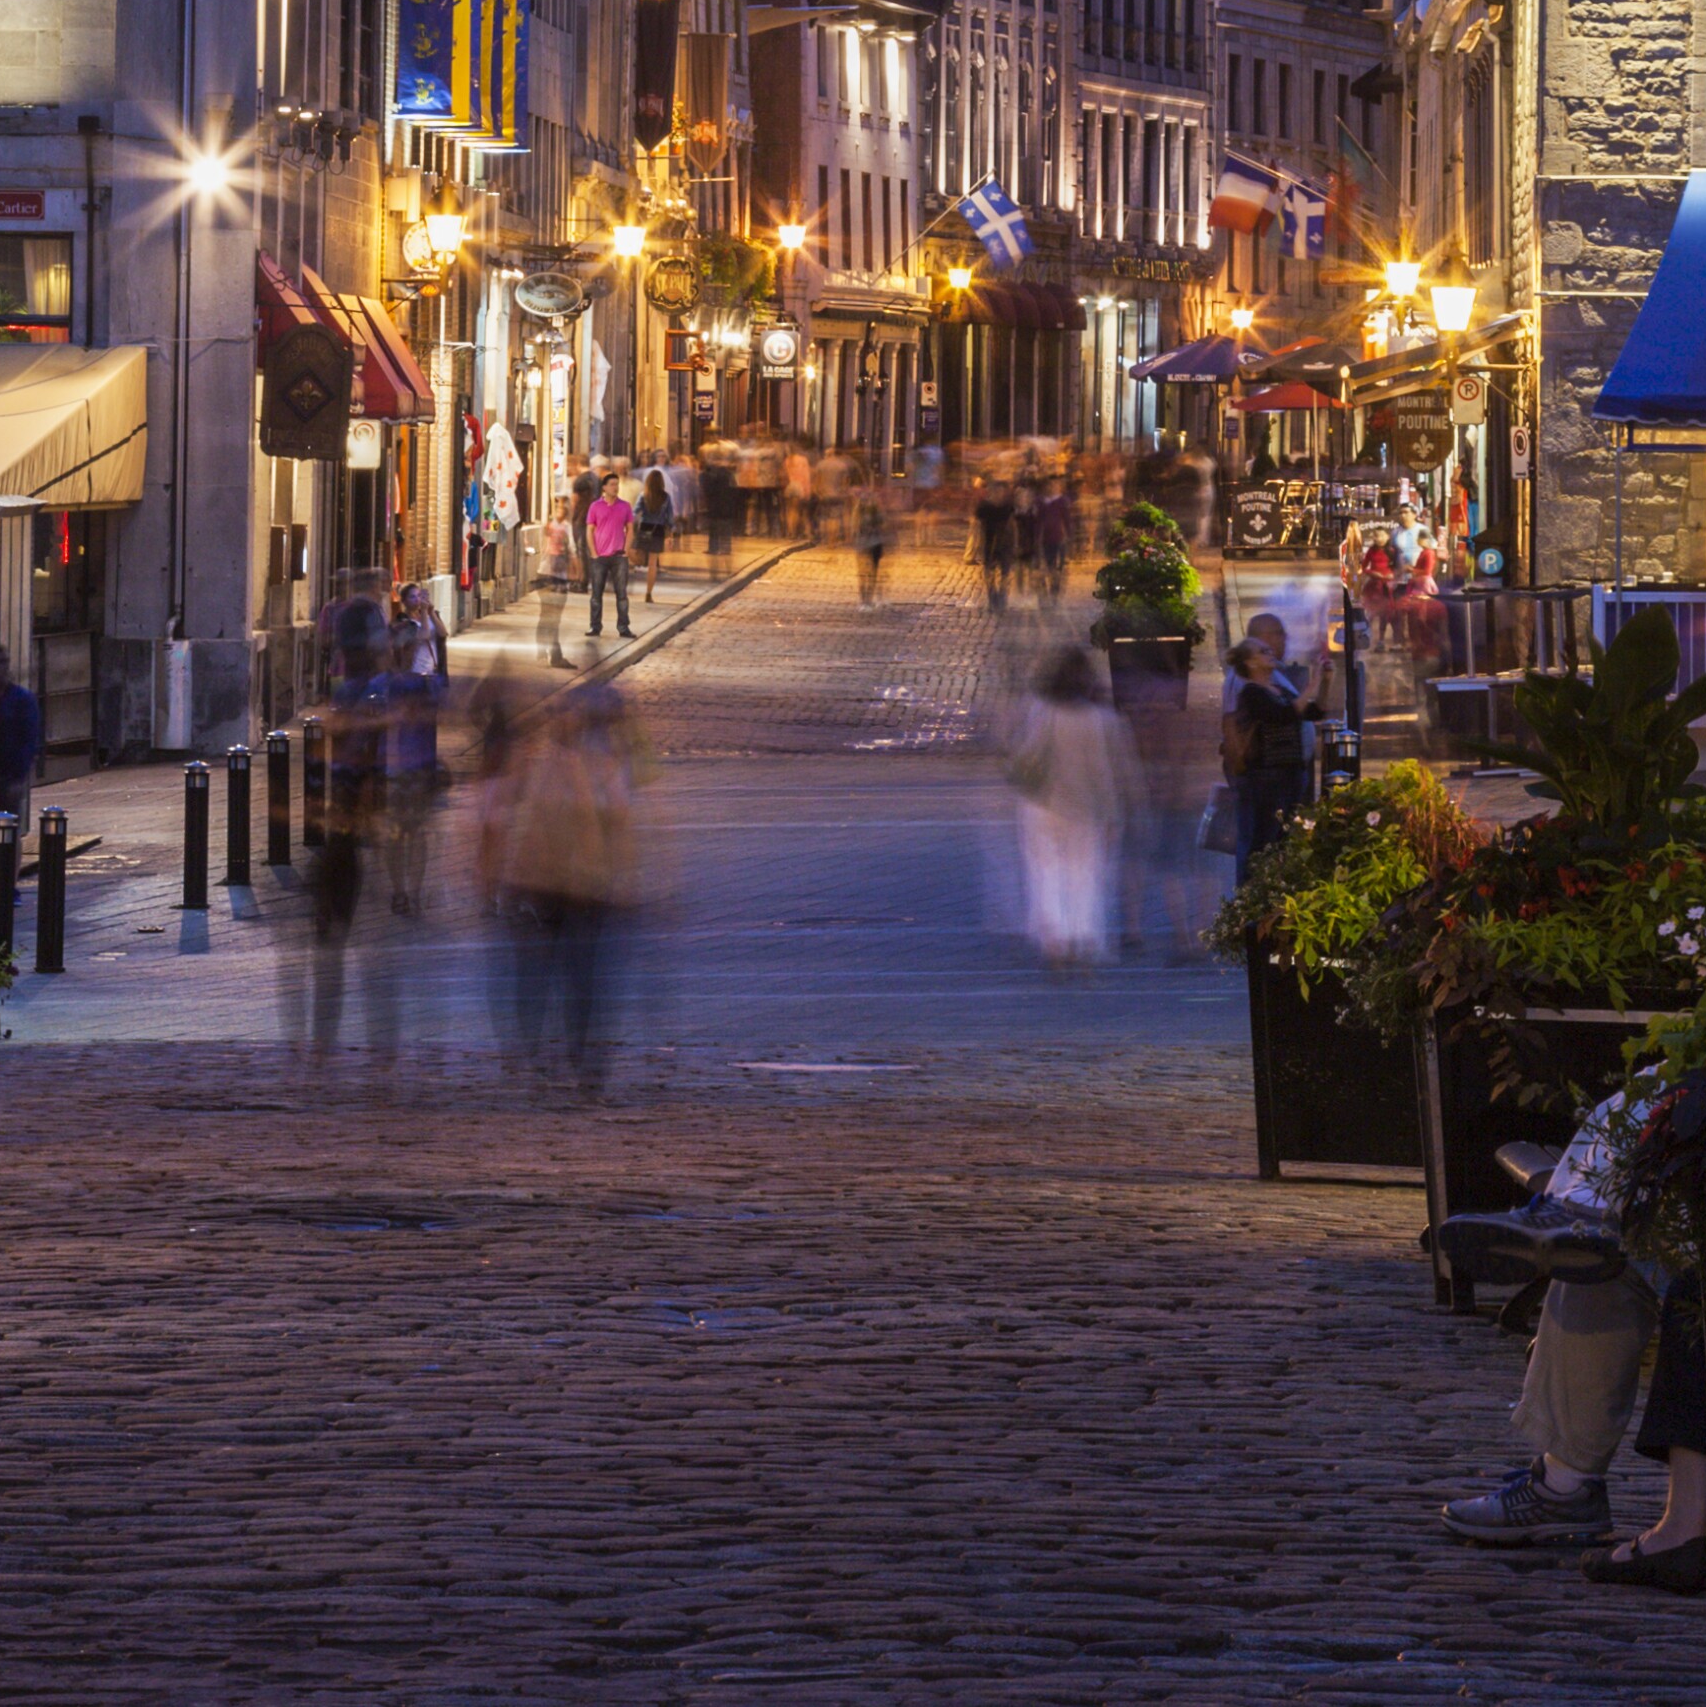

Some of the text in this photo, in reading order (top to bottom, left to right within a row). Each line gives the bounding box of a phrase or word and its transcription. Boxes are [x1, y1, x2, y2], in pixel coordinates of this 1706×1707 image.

[1397, 396, 1450, 408] MONTRL
[1398, 414, 1449, 430] POUTINE
[1236, 491, 1277, 504] MONTREAL
[1241, 502, 1272, 513] POUTINE
